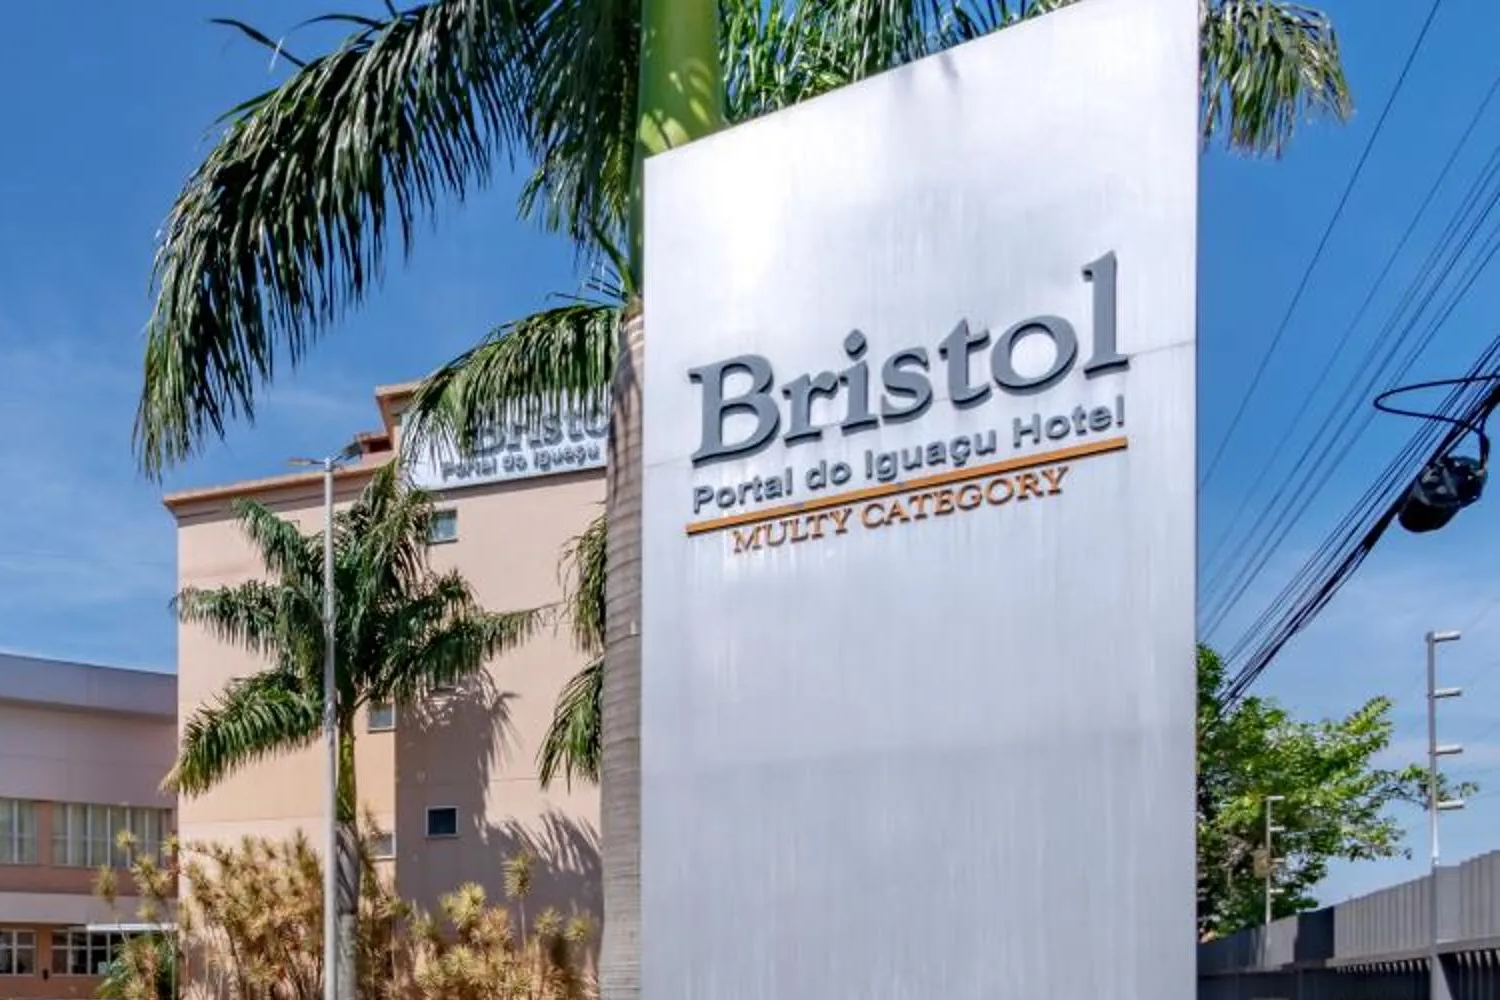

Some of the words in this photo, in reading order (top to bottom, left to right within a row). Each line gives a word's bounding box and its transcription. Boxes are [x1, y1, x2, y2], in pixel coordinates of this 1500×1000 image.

[688, 250, 1131, 468] Bristol
[693, 467, 793, 514] Portal
[805, 459, 852, 490] do
[865, 429, 997, 482] Iguaçu
[1013, 393, 1125, 448] Hotel
[732, 507, 852, 553] MULTY
[861, 466, 1069, 529] CATEGORY
